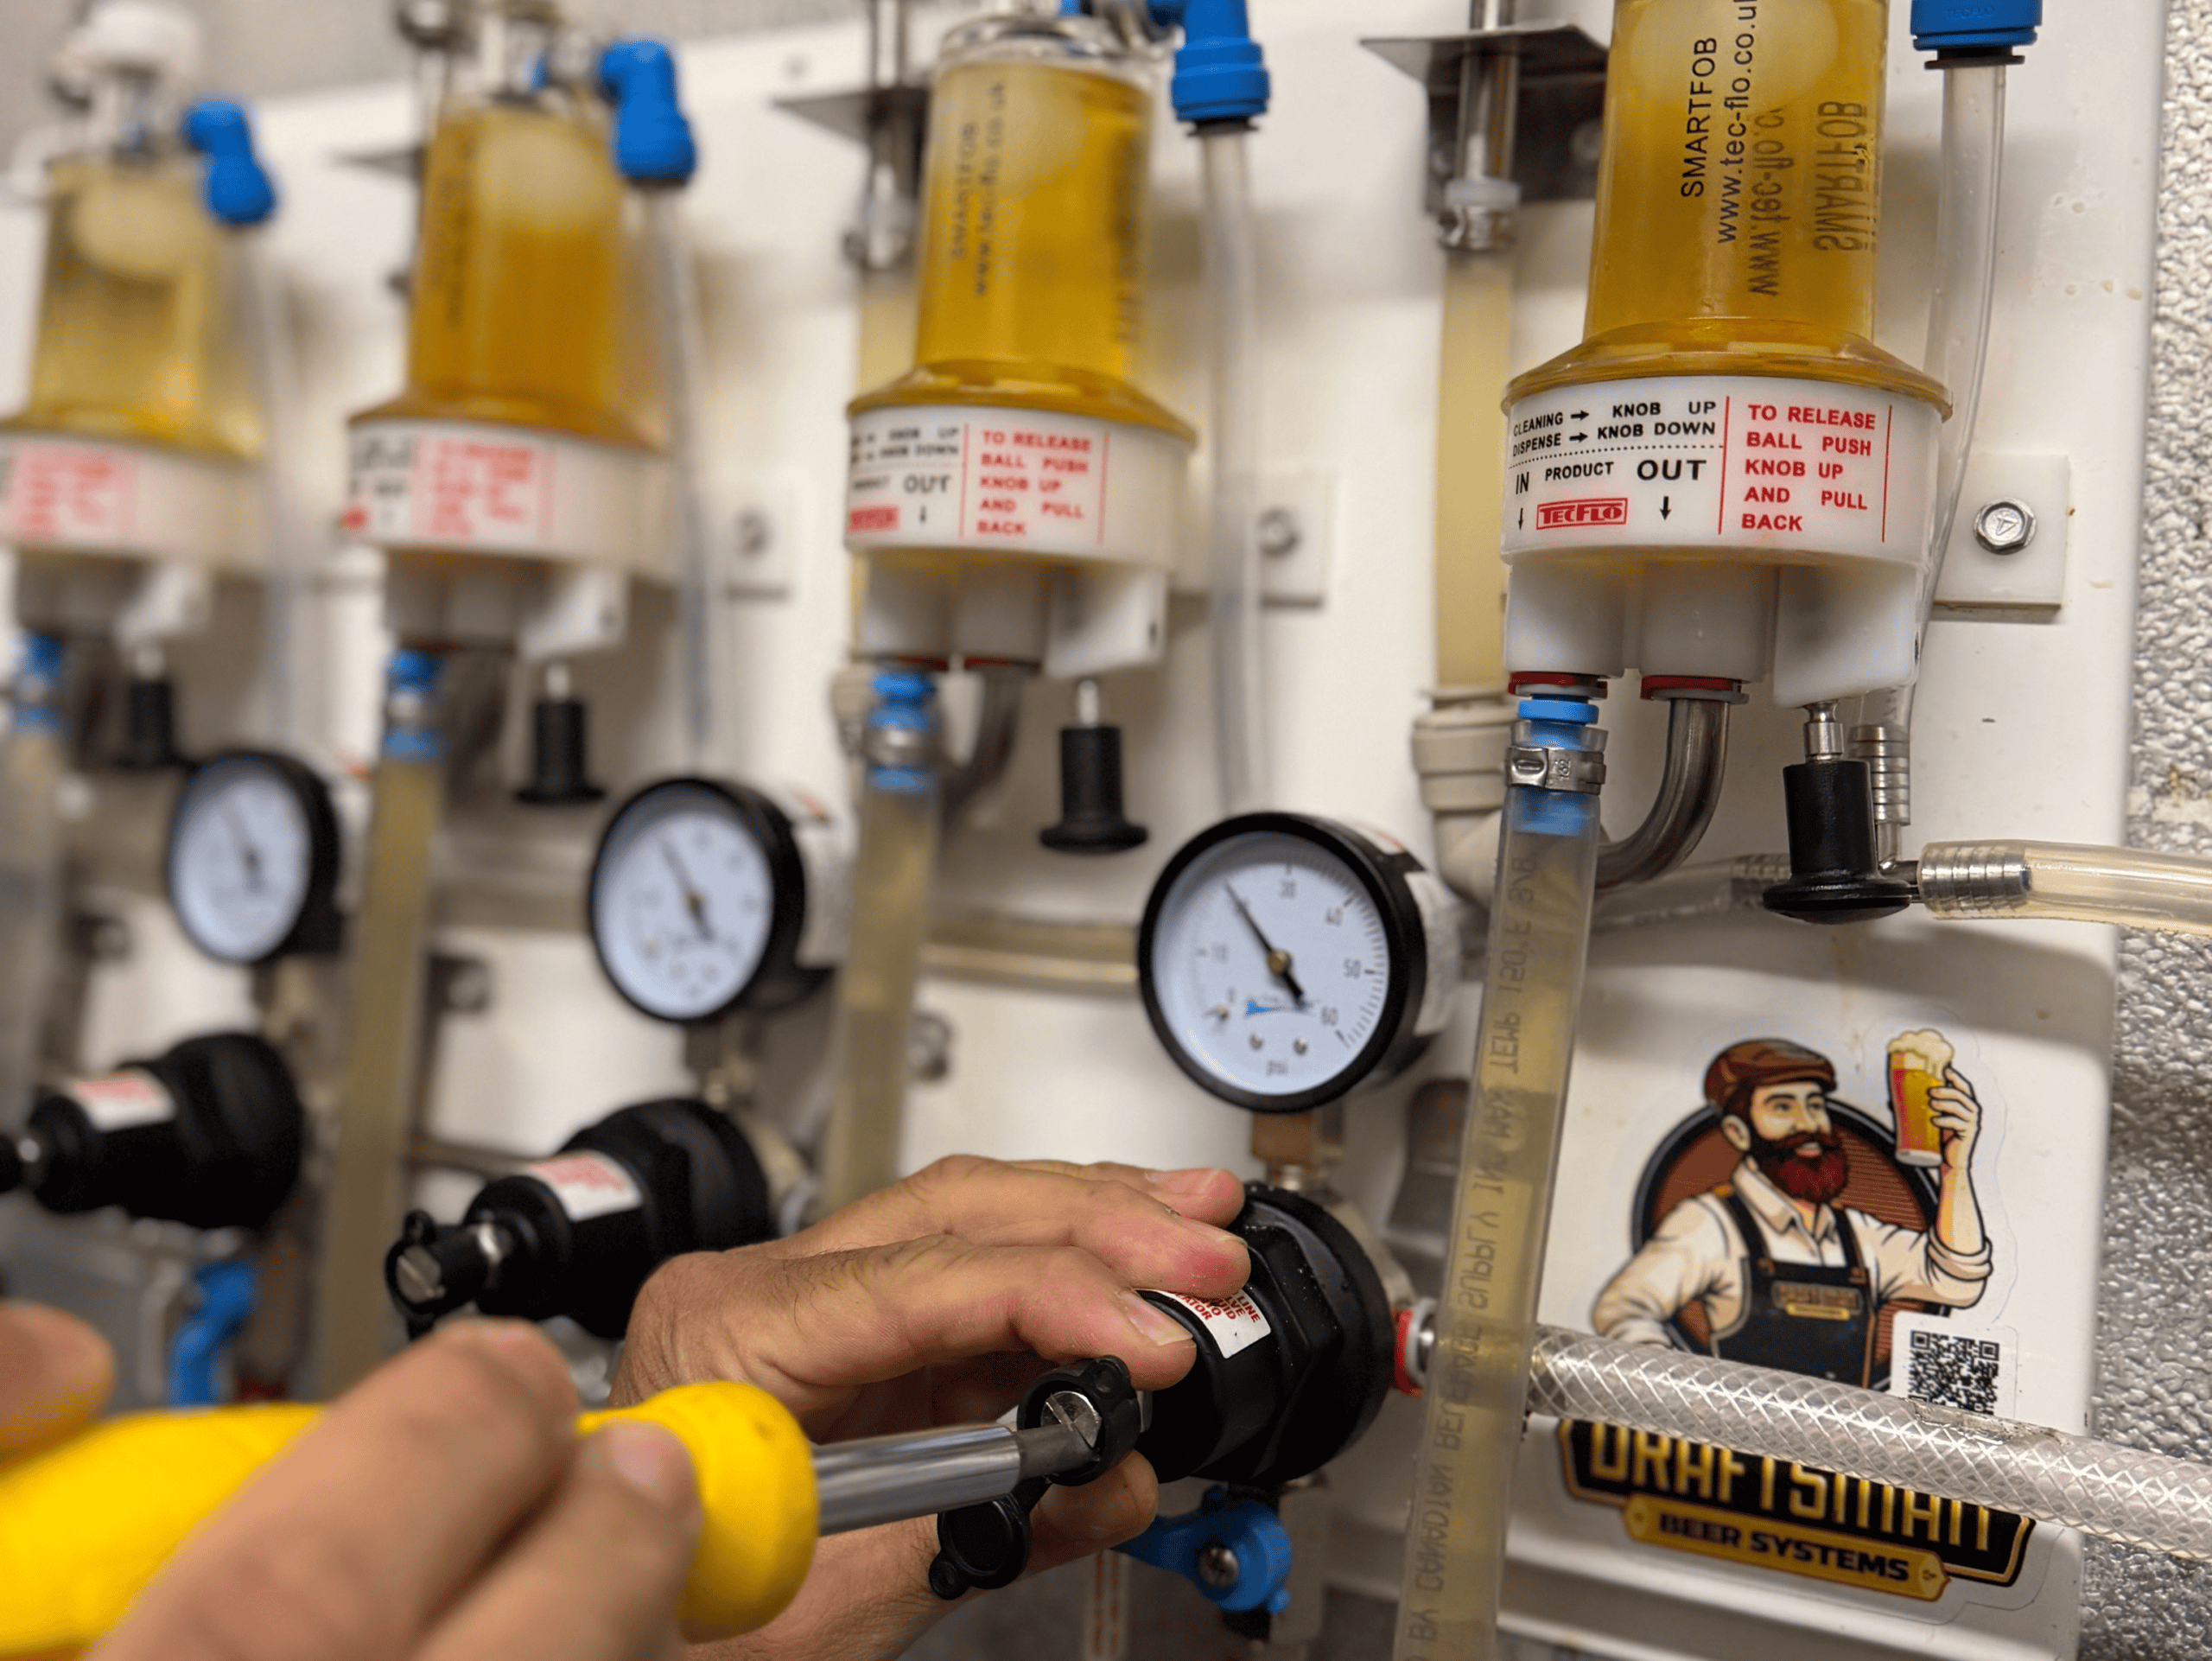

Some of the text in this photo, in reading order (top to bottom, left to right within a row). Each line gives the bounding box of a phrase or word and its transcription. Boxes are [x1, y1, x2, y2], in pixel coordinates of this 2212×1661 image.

[1681, 38, 1717, 197] SMARTFOB
[1514, 401, 1717, 436] CLEANING KNOB UP
[1748, 404, 1876, 430] TO RELEASE
[982, 430, 1091, 454] TO RELEASE
[1513, 422, 1715, 457] DISPENSE KNOB DOWN
[1746, 431, 1872, 456] BALL PUSH
[981, 453, 1089, 473] BALL PUSH
[1745, 459, 1844, 480] KNOB UP
[904, 474, 951, 493] OUT
[979, 475, 1062, 493] KNOB UP
[1516, 459, 1707, 494] IN PRODUCT OUT
[979, 497, 1084, 519] AND PULL
[1744, 487, 1867, 511] AND PULL
[976, 519, 1026, 536] BACK
[1741, 513, 1802, 531] BACK
[1216, 1298, 1236, 1320] UID
[1224, 1296, 1245, 1316] LVE
[1237, 1295, 1261, 1323] LINE
[1660, 1512, 1910, 1581] BEER SYSTEMS
